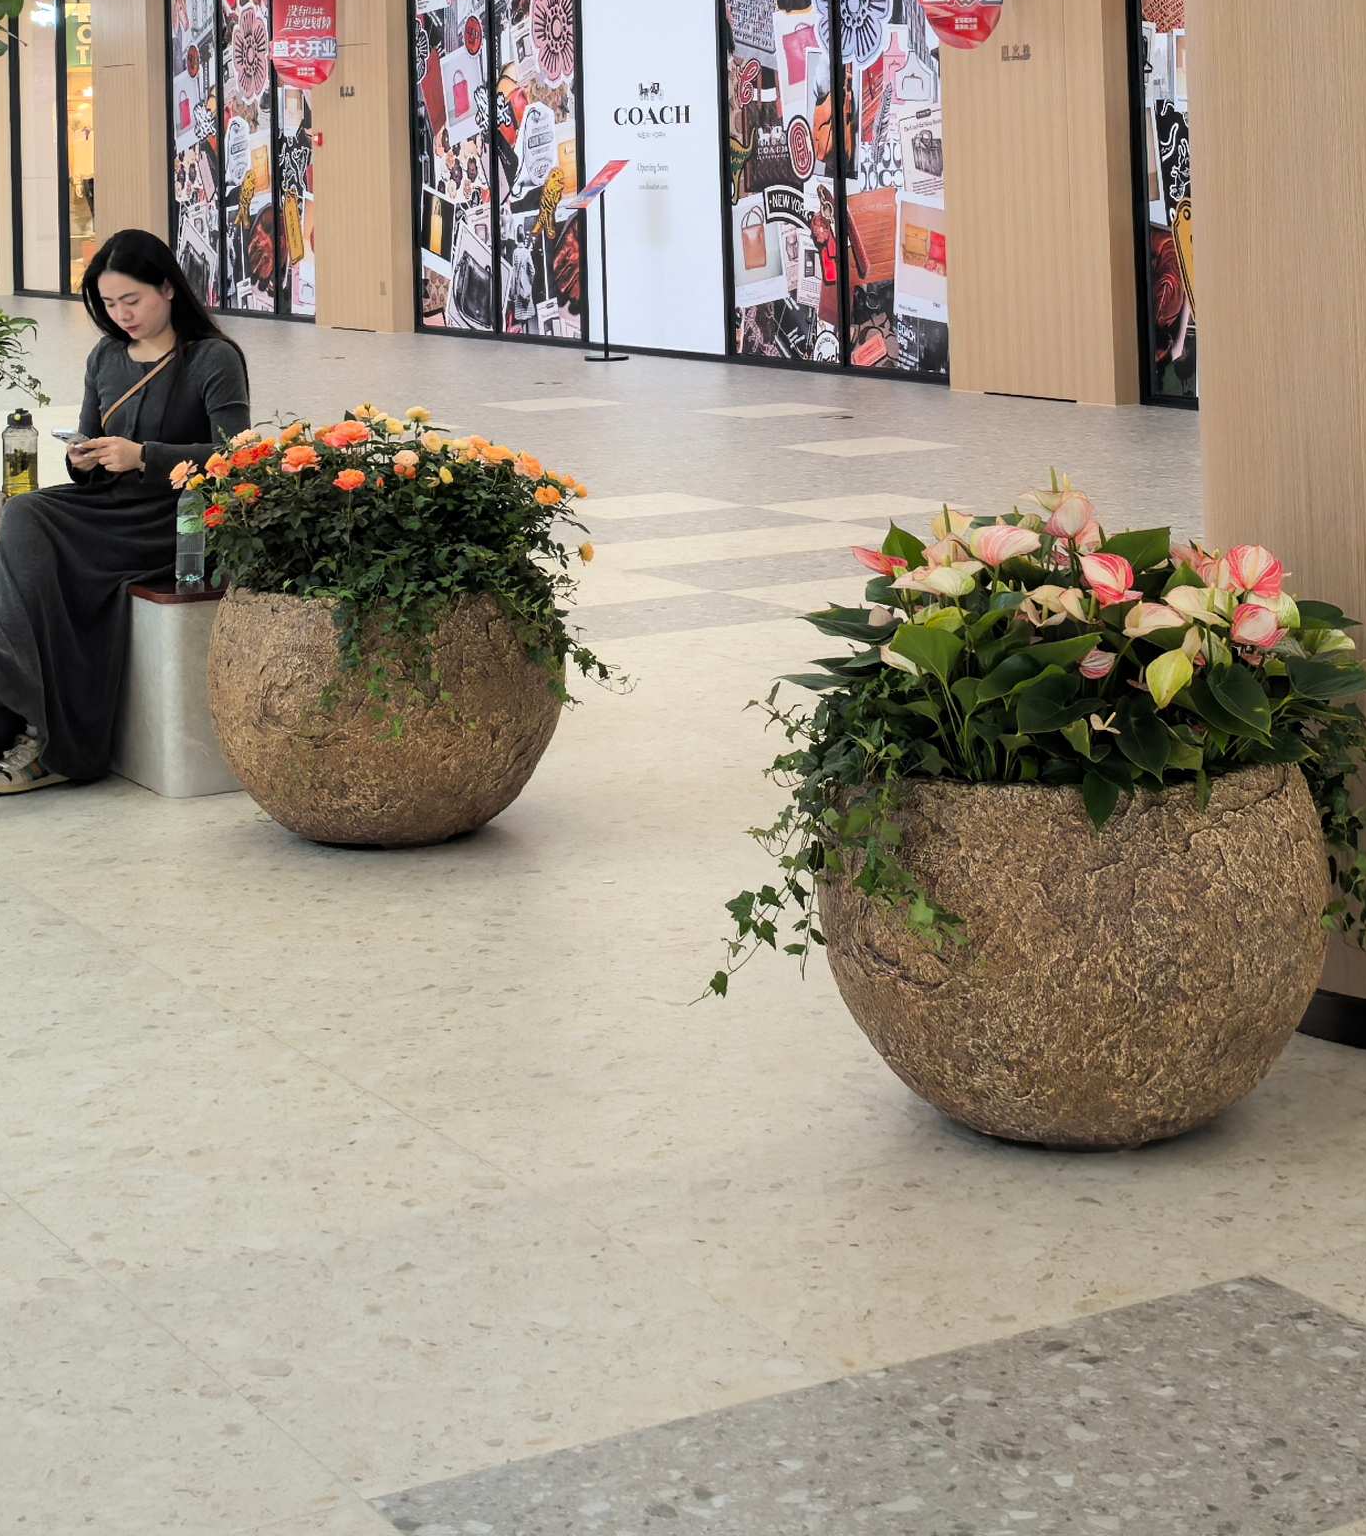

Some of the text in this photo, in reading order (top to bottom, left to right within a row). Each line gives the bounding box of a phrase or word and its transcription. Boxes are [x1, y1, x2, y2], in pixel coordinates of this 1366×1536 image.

[272, 39, 337, 58] 盛大开业
[613, 104, 691, 126] COACH
[772, 194, 791, 209] NEW
